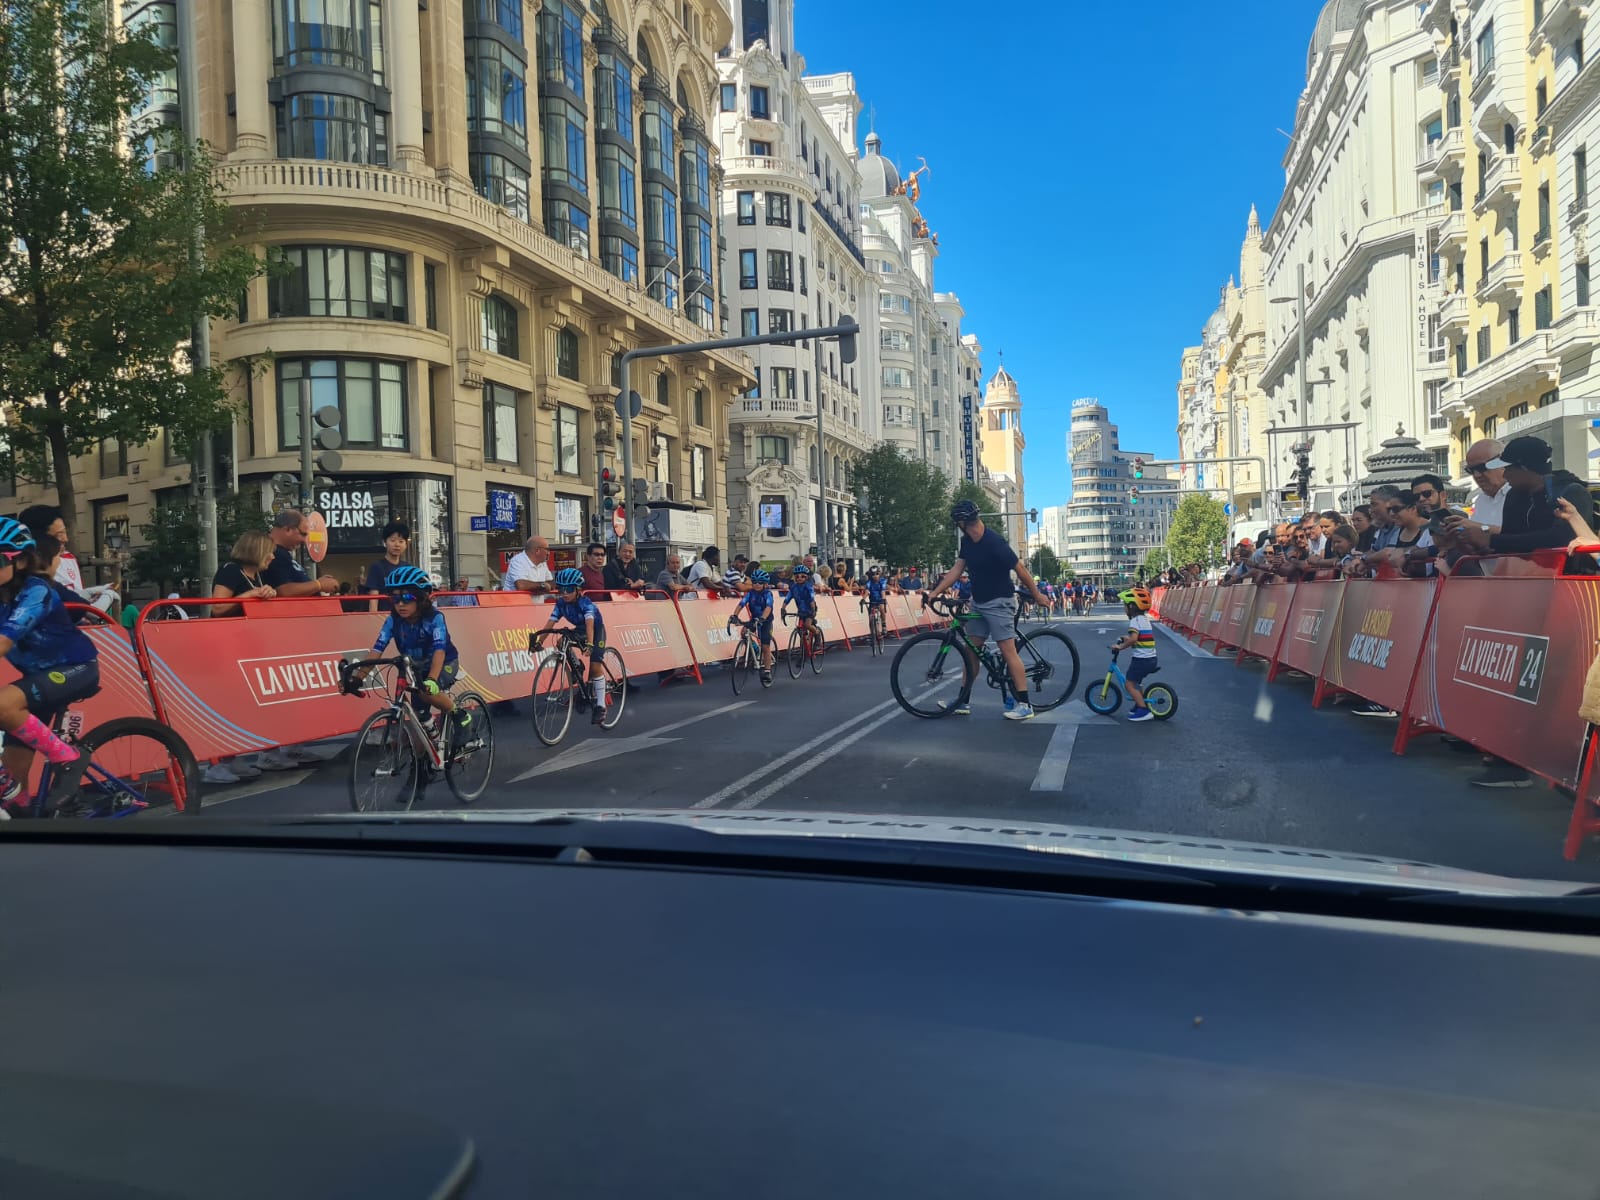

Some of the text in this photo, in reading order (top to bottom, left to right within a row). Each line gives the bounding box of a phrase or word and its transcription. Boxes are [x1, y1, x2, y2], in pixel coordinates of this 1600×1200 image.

[1417, 236, 1425, 268] THIS
[1418, 273, 1425, 289] IS
[1418, 306, 1426, 347] HOTEL
[964, 409, 972, 446] HOTEL
[320, 491, 373, 509] SALSA
[495, 496, 512, 510] SALSA
[325, 510, 374, 527] JEANS
[496, 510, 513, 522] JEANS
[490, 630, 508, 652] LA
[620, 625, 664, 648] LA VUELTA 24
[486, 652, 512, 677] QUE
[511, 649, 535, 673] NOS
[1460, 637, 1543, 689] LA VUELTA 24
[255, 666, 285, 696] LA
